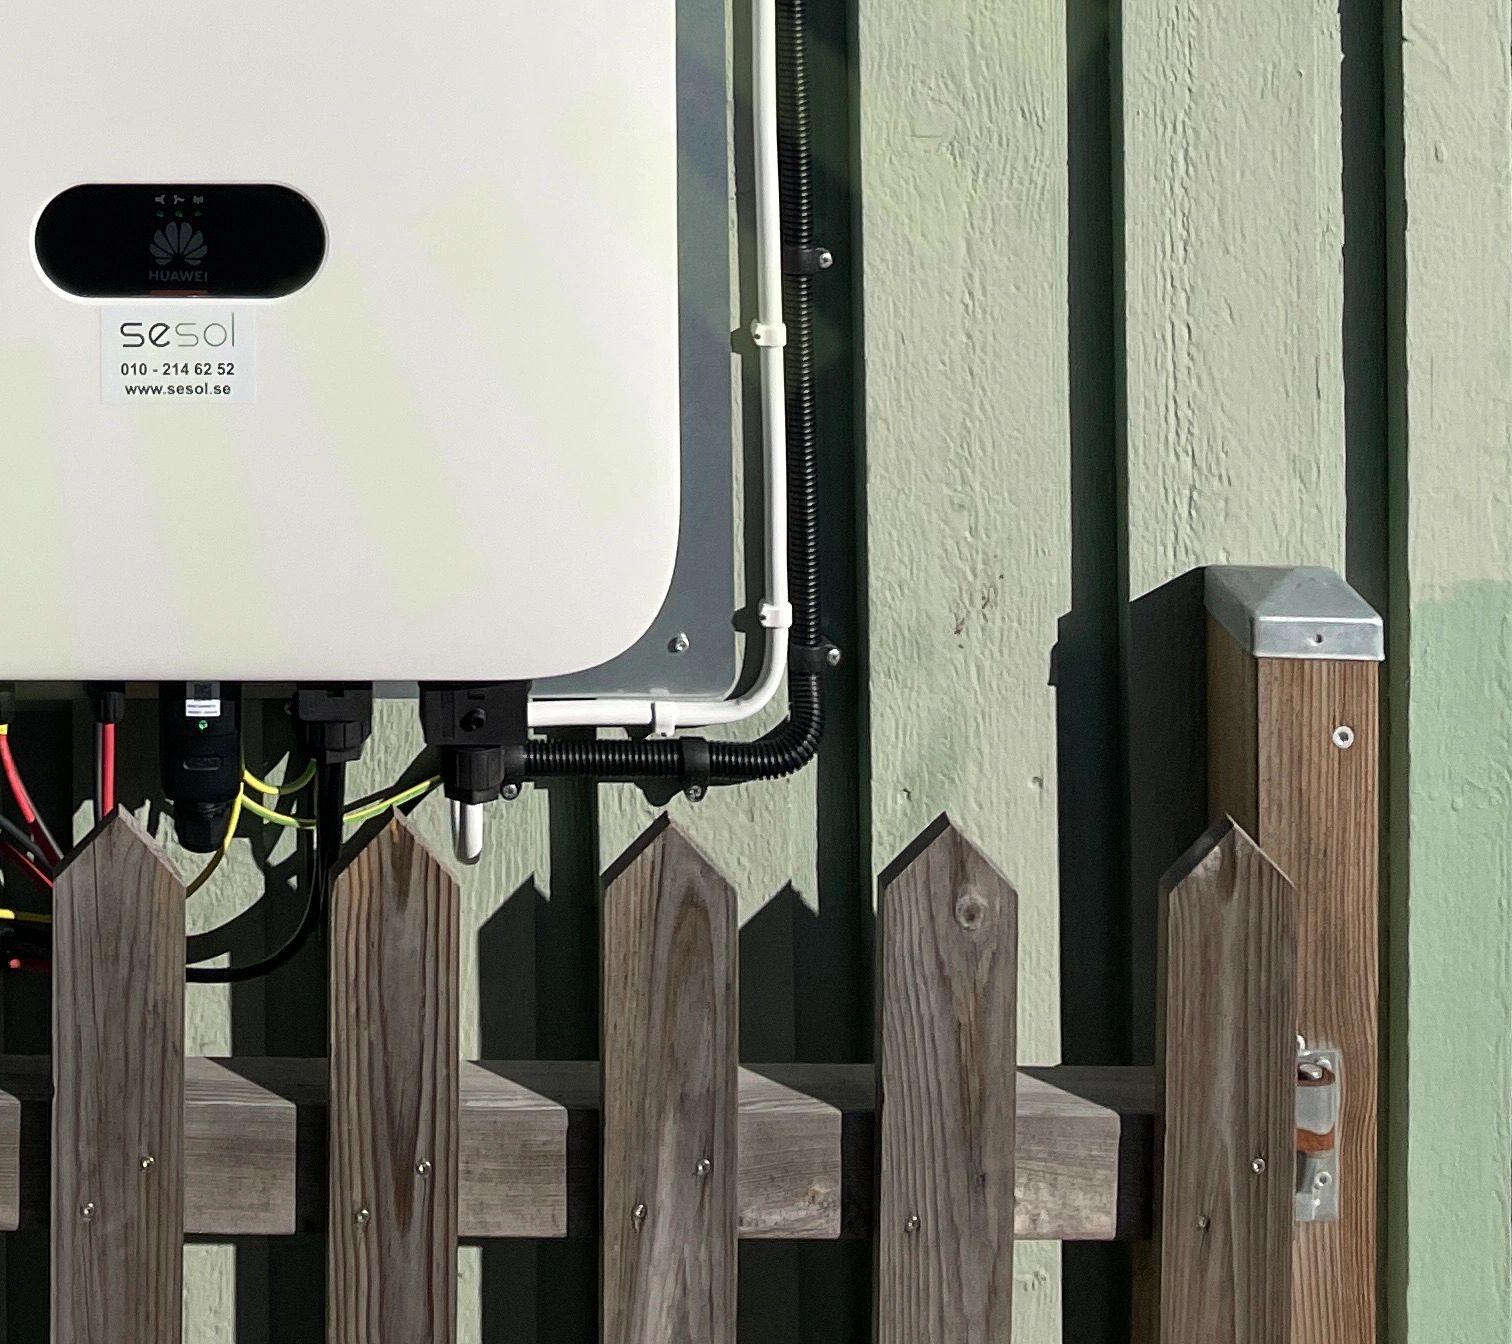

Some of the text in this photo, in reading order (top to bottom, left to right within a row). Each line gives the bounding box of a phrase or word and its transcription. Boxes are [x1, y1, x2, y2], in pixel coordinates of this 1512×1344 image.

[149, 270, 208, 282] HUAWEI
[120, 312, 235, 348] sesol
[121, 364, 147, 376] 010
[163, 364, 189, 376] 214
[194, 364, 214, 376] 62
[217, 364, 235, 376] 52
[125, 382, 231, 395] www.sesol.se
